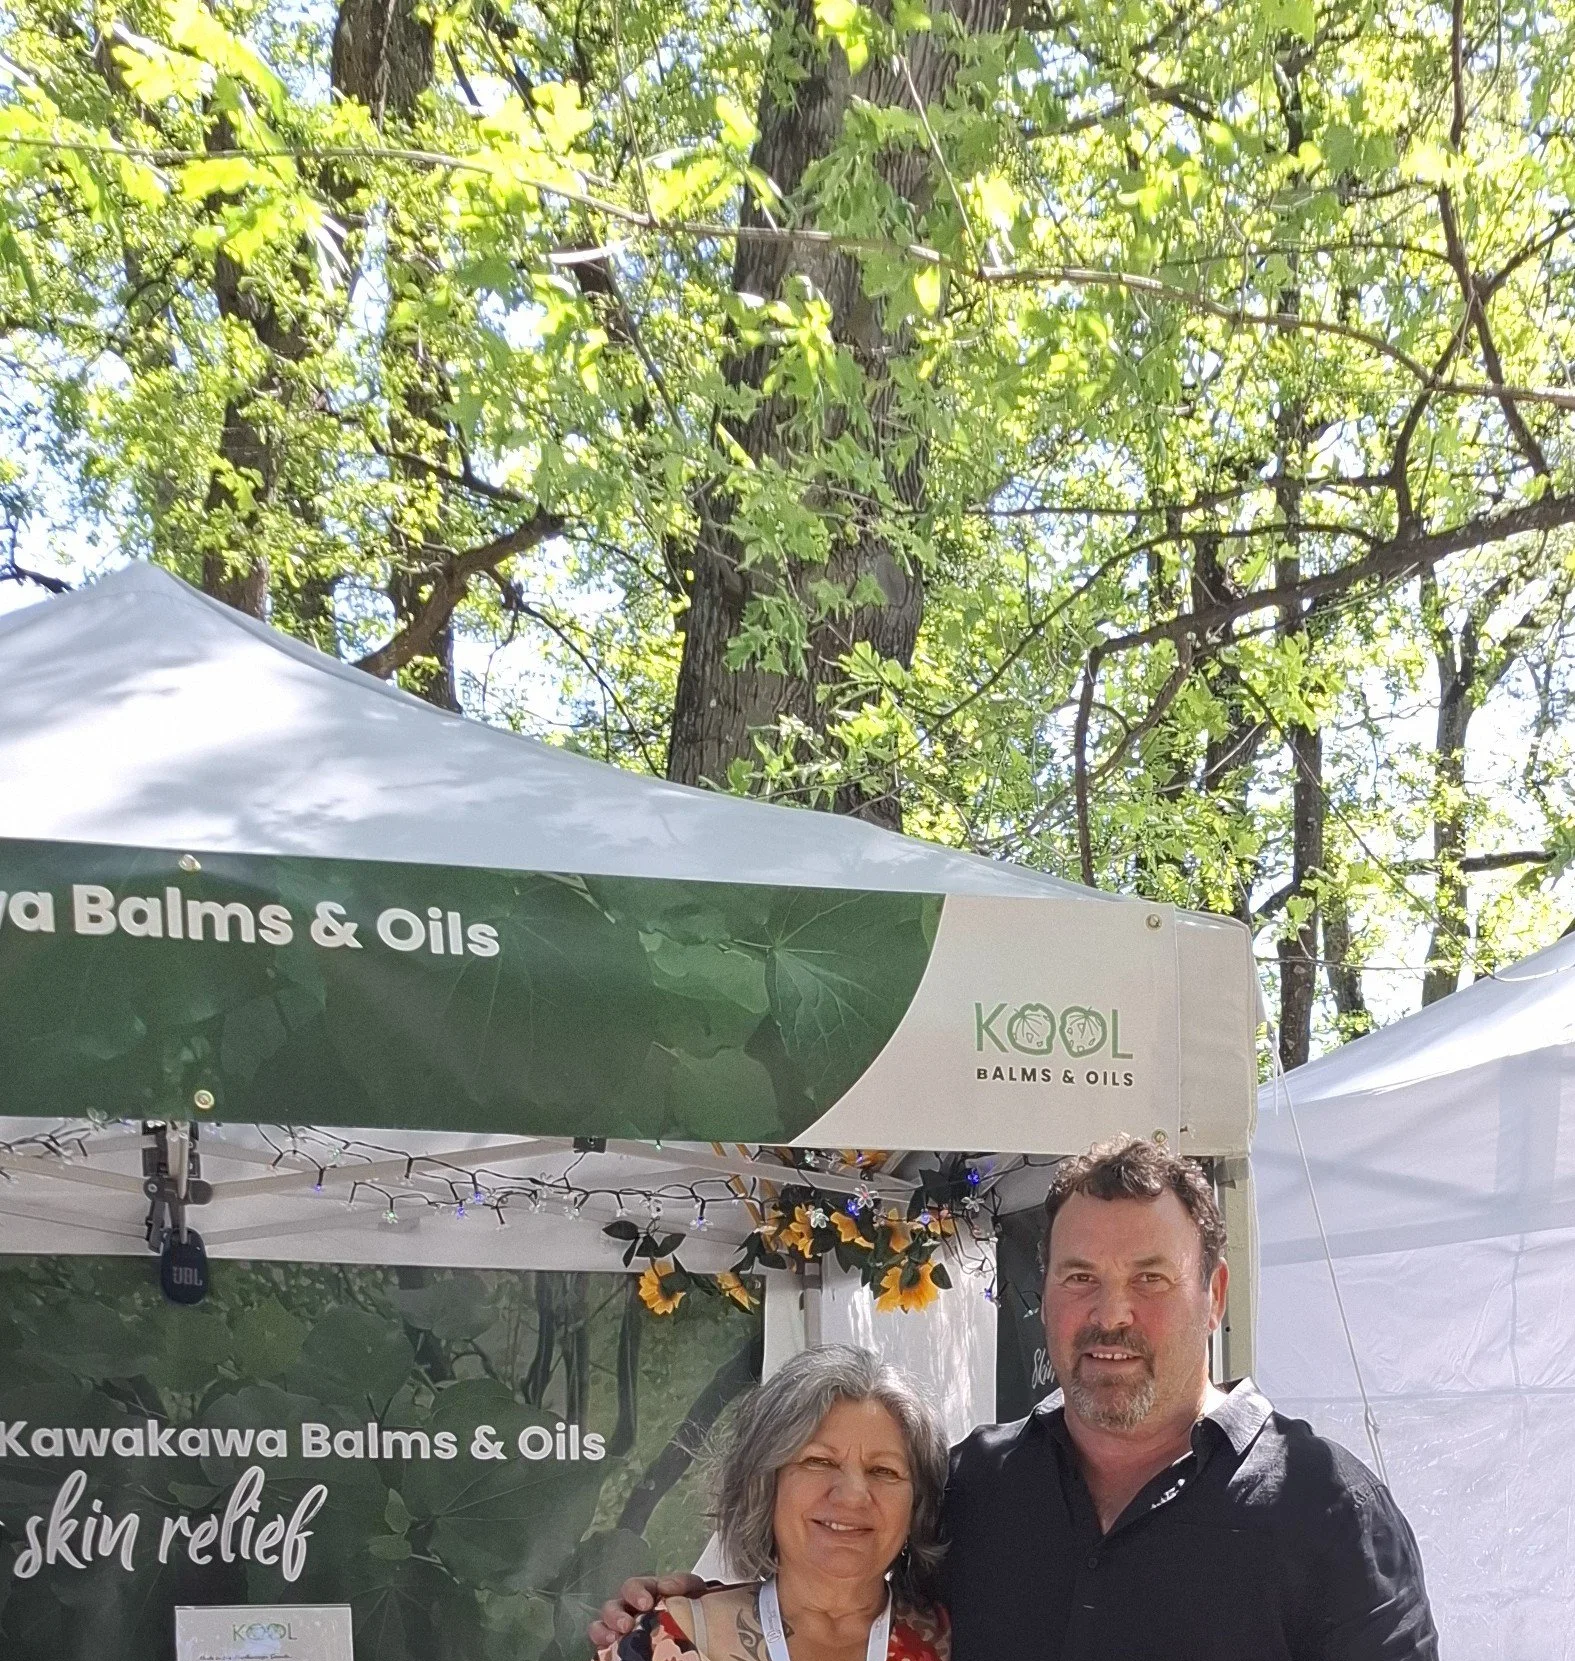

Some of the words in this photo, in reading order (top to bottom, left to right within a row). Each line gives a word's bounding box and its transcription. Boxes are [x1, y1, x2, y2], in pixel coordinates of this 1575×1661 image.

[72, 884, 294, 945] Balms
[310, 901, 364, 949] &
[376, 907, 500, 957] Oils
[974, 1002, 1134, 1059] KOOL
[976, 1066, 1052, 1082] BALMS
[1062, 1069, 1075, 1084] &
[1086, 1071, 1134, 1086] OILS
[172, 1266, 204, 1286] JBL
[0, 1419, 288, 1458] Kawakawa
[301, 1422, 459, 1459] Balms
[470, 1425, 508, 1460] &
[518, 1422, 607, 1460] Oils
[13, 1469, 140, 1578] skin
[159, 1465, 329, 1582] relief
[232, 1623, 298, 1641] KOOL
